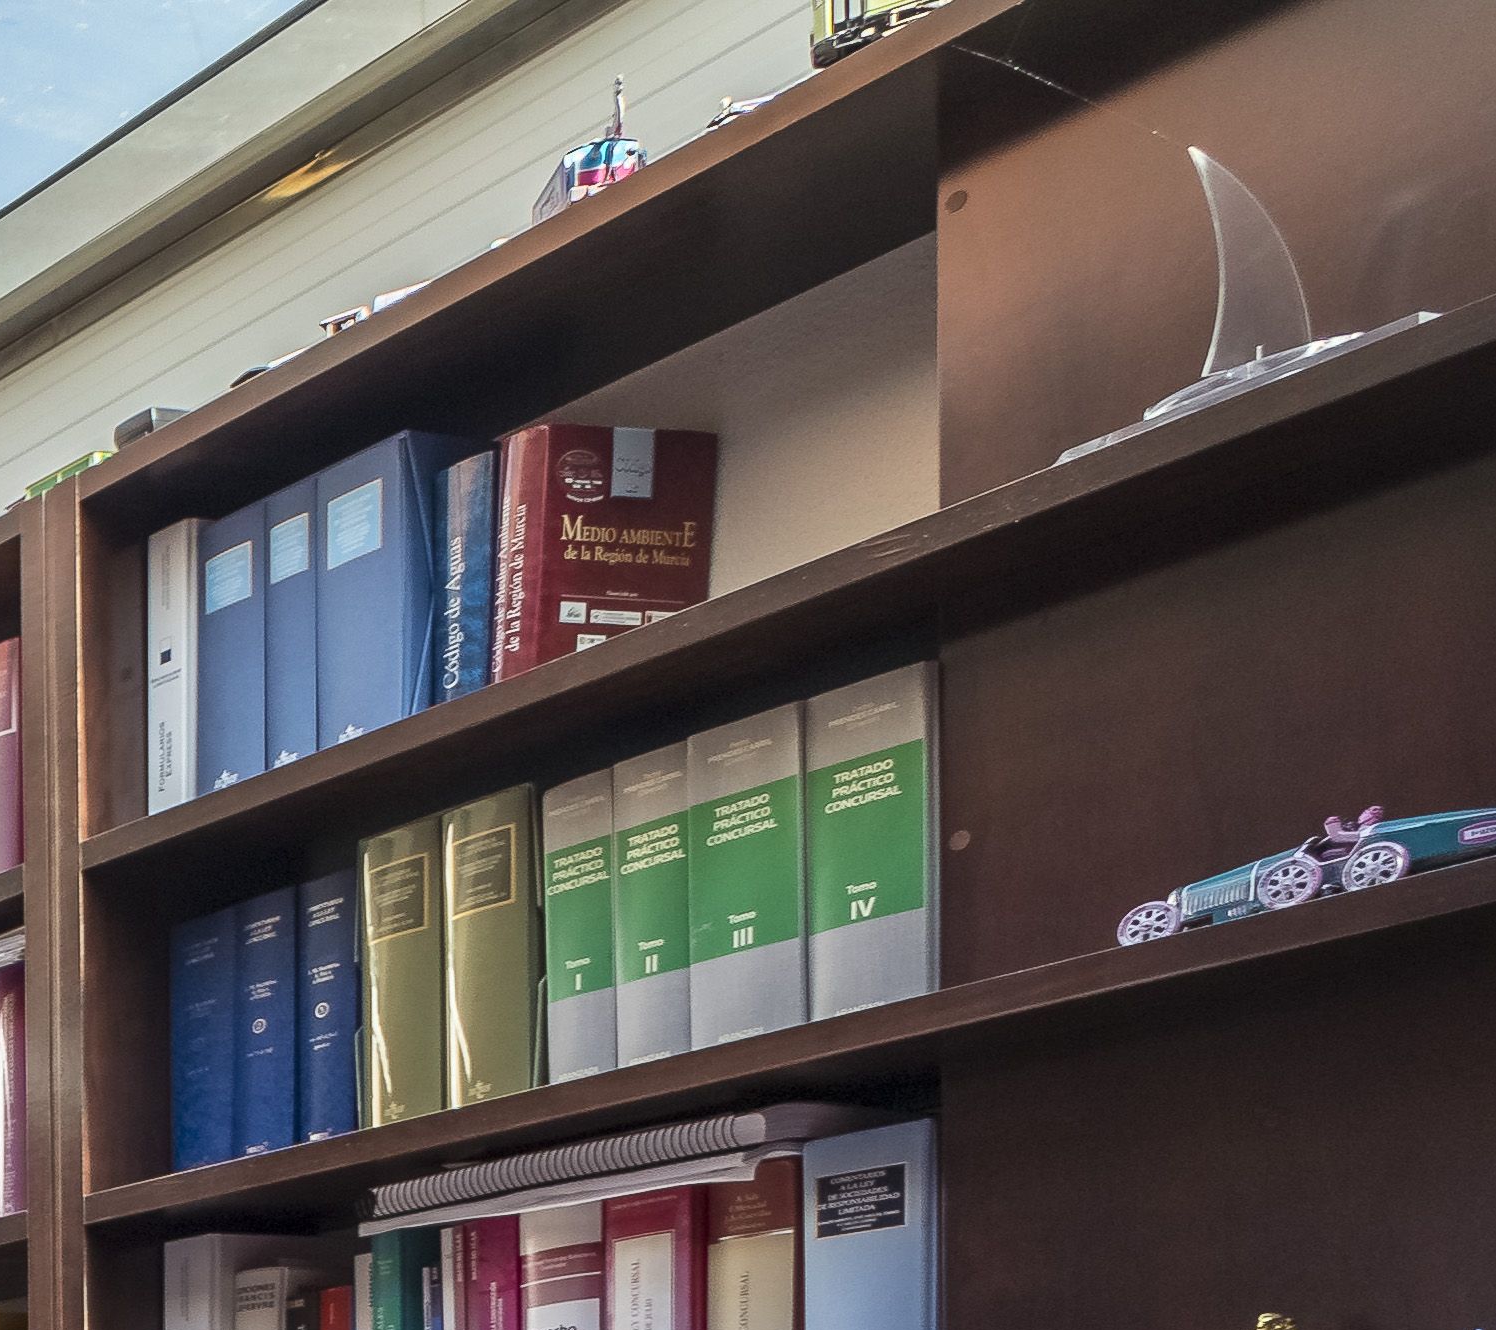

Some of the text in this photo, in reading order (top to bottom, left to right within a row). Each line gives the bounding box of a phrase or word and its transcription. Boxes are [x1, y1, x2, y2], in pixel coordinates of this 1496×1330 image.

[561, 514, 696, 549] MEDIO AMBIENTE
[564, 546, 578, 560] de
[581, 547, 591, 560] la
[594, 548, 633, 564] Región
[636, 551, 650, 563] de
[506, 504, 527, 652] de la Región de Murcia
[442, 536, 465, 689] Código de Aguas
[832, 757, 895, 784] TRATADO
[714, 792, 771, 818] TRATADO
[824, 785, 903, 815] CONCURSAL
[627, 823, 679, 847] TRATADO
[706, 818, 778, 848] CONCURSAL
[553, 847, 603, 868] TRATADO
[620, 849, 686, 876] CONCURSAL
[547, 870, 611, 897] CONCURSAL
[845, 880, 878, 895] Tomo
[727, 910, 758, 925] Tomo
[849, 896, 876, 921] IV
[637, 939, 665, 951] Tomo
[732, 926, 754, 949] III
[564, 957, 591, 970] Tomo
[644, 953, 659, 974] II
[574, 972, 583, 991] I
